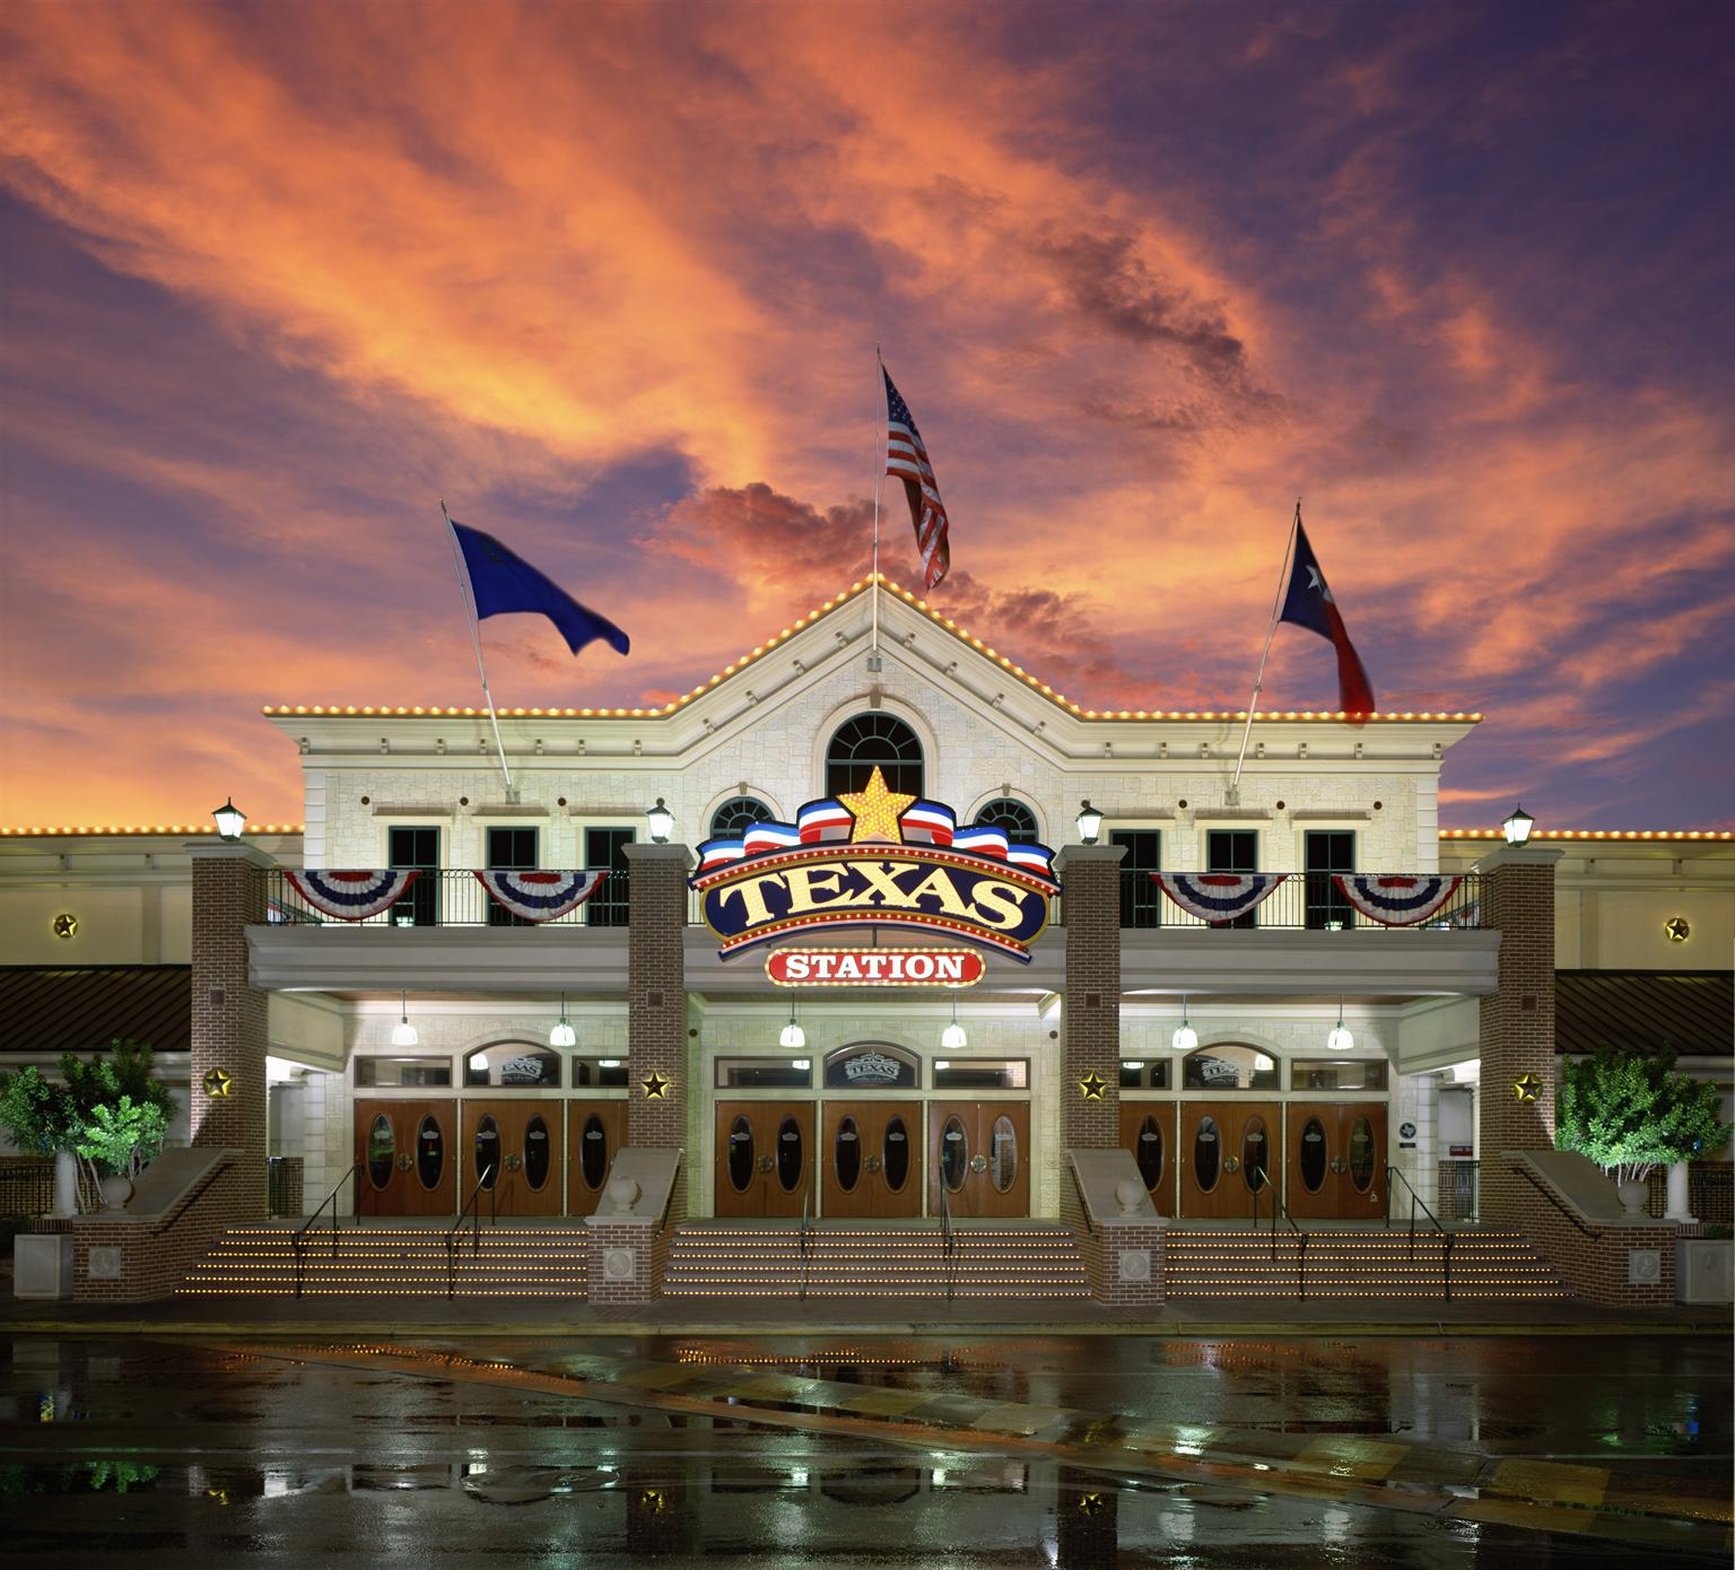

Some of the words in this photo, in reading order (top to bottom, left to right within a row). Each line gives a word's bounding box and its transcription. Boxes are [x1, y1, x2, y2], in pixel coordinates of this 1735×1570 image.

[719, 861, 1029, 930] TEXAS
[785, 954, 966, 979] STATION
[850, 1064, 896, 1075] TEXAS
